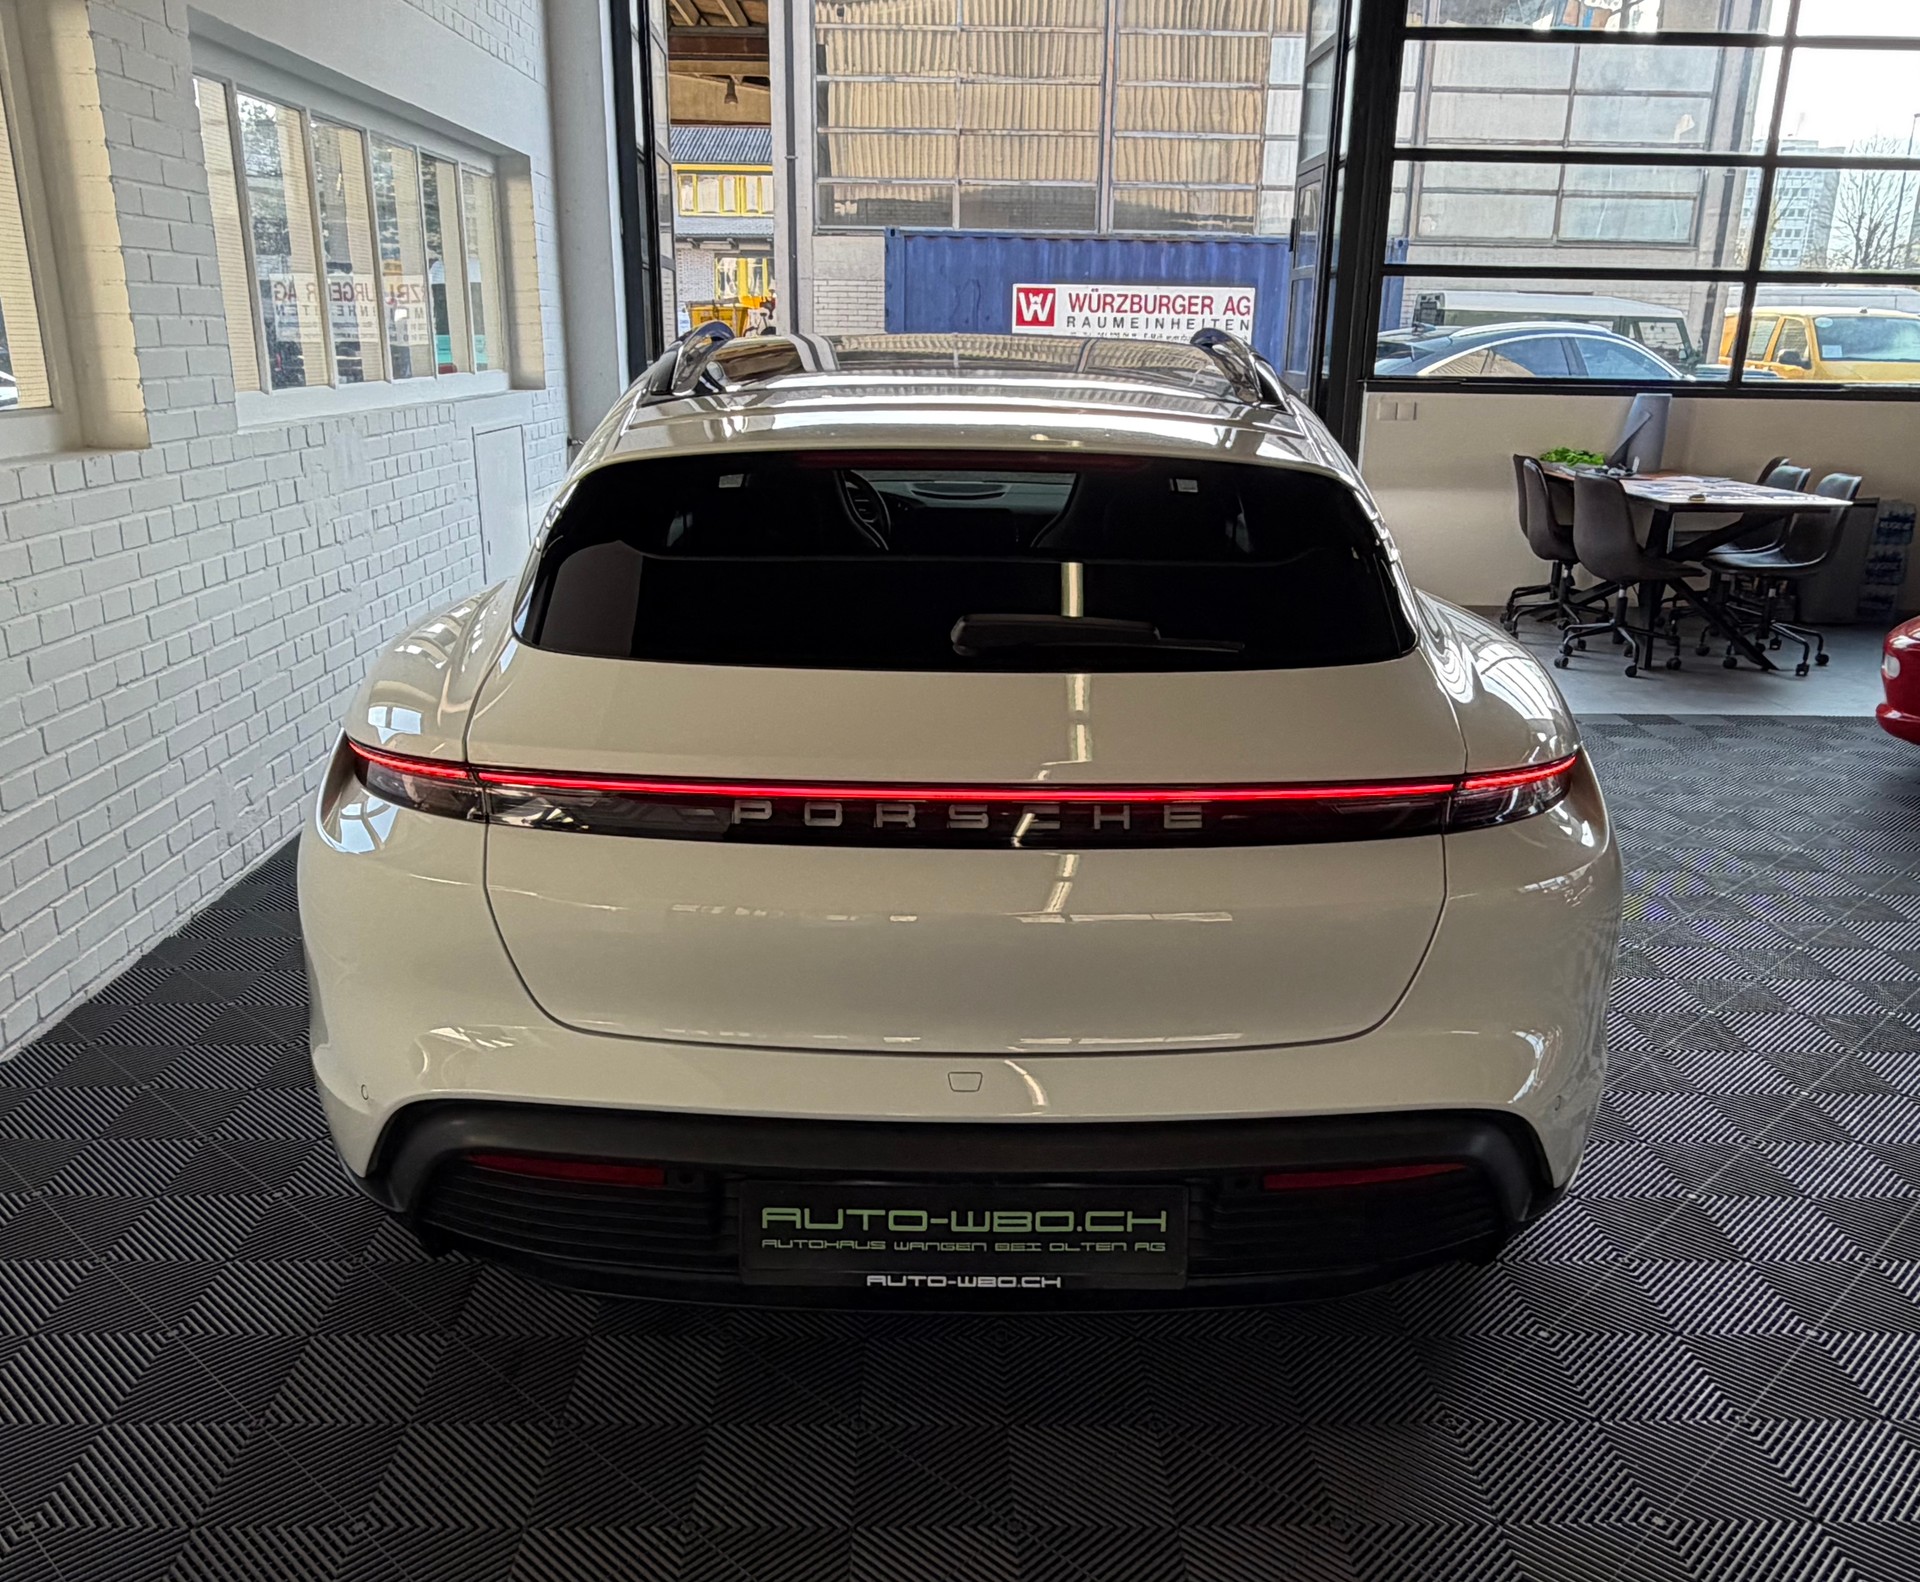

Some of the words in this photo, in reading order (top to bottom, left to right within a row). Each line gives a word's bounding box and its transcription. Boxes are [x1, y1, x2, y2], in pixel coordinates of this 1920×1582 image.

[1069, 288, 1215, 316] WÜRZBURGER
[1223, 295, 1251, 316] AG
[1066, 315, 1250, 332] RAUMEINHEITEN
[731, 798, 1206, 830] PORSCHE
[761, 1206, 1168, 1233] AUTO-WBO.CH
[761, 1238, 887, 1251] AUTOHAUS
[893, 1240, 988, 1252] WANGEN
[994, 1242, 1042, 1252] BEI
[1049, 1241, 1128, 1252] OLTEN
[1134, 1241, 1167, 1252] AG
[866, 1274, 1063, 1290] AUTO-WBO.CH
